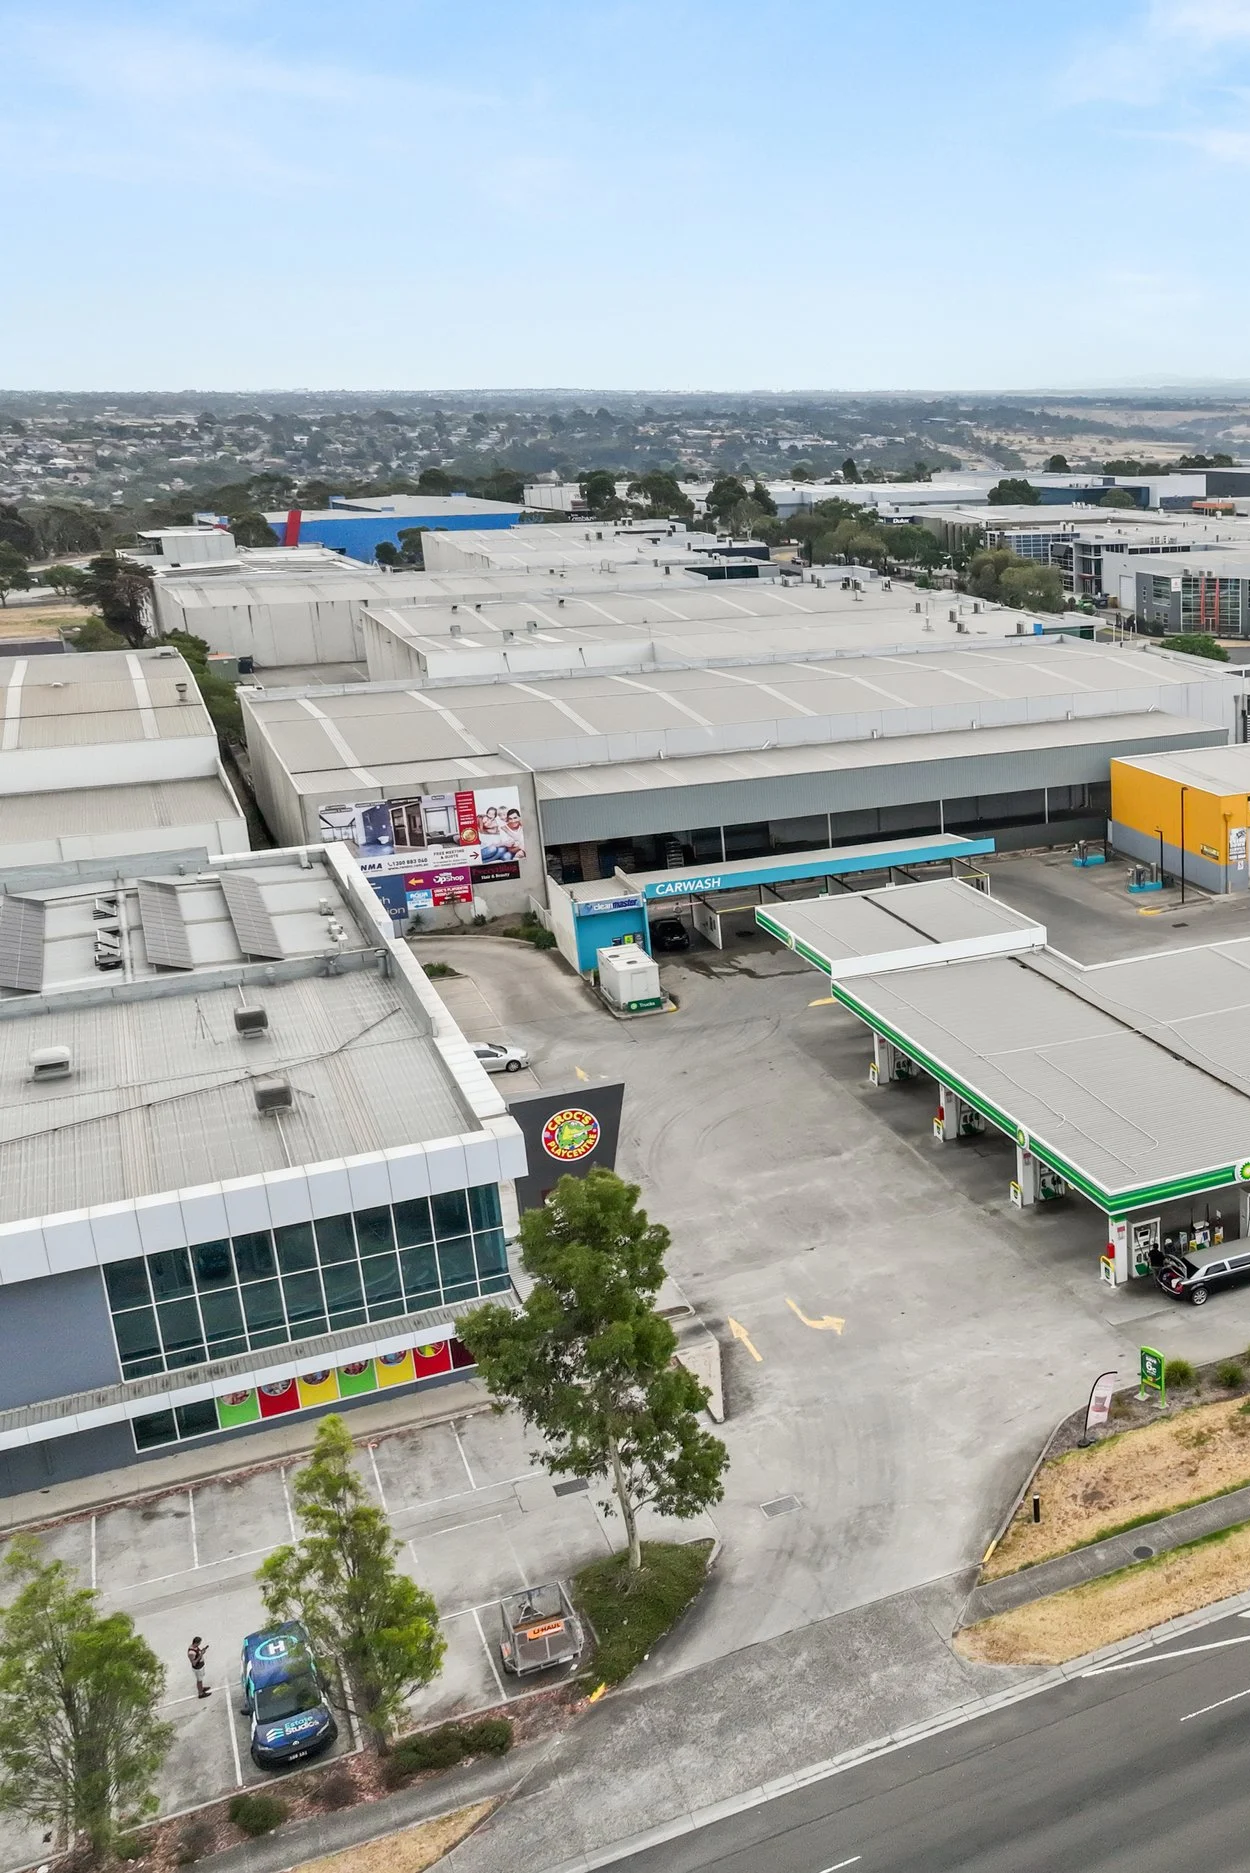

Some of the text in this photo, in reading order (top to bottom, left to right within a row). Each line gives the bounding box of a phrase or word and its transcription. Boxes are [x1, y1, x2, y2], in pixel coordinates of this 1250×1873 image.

[655, 877, 721, 895] CARWASH
[547, 1111, 592, 1131] CROC'S
[547, 1133, 597, 1158] PLAYCENTRE
[267, 1640, 286, 1655] H
[284, 1715, 313, 1729] Estate
[285, 1720, 320, 1735] Studios
